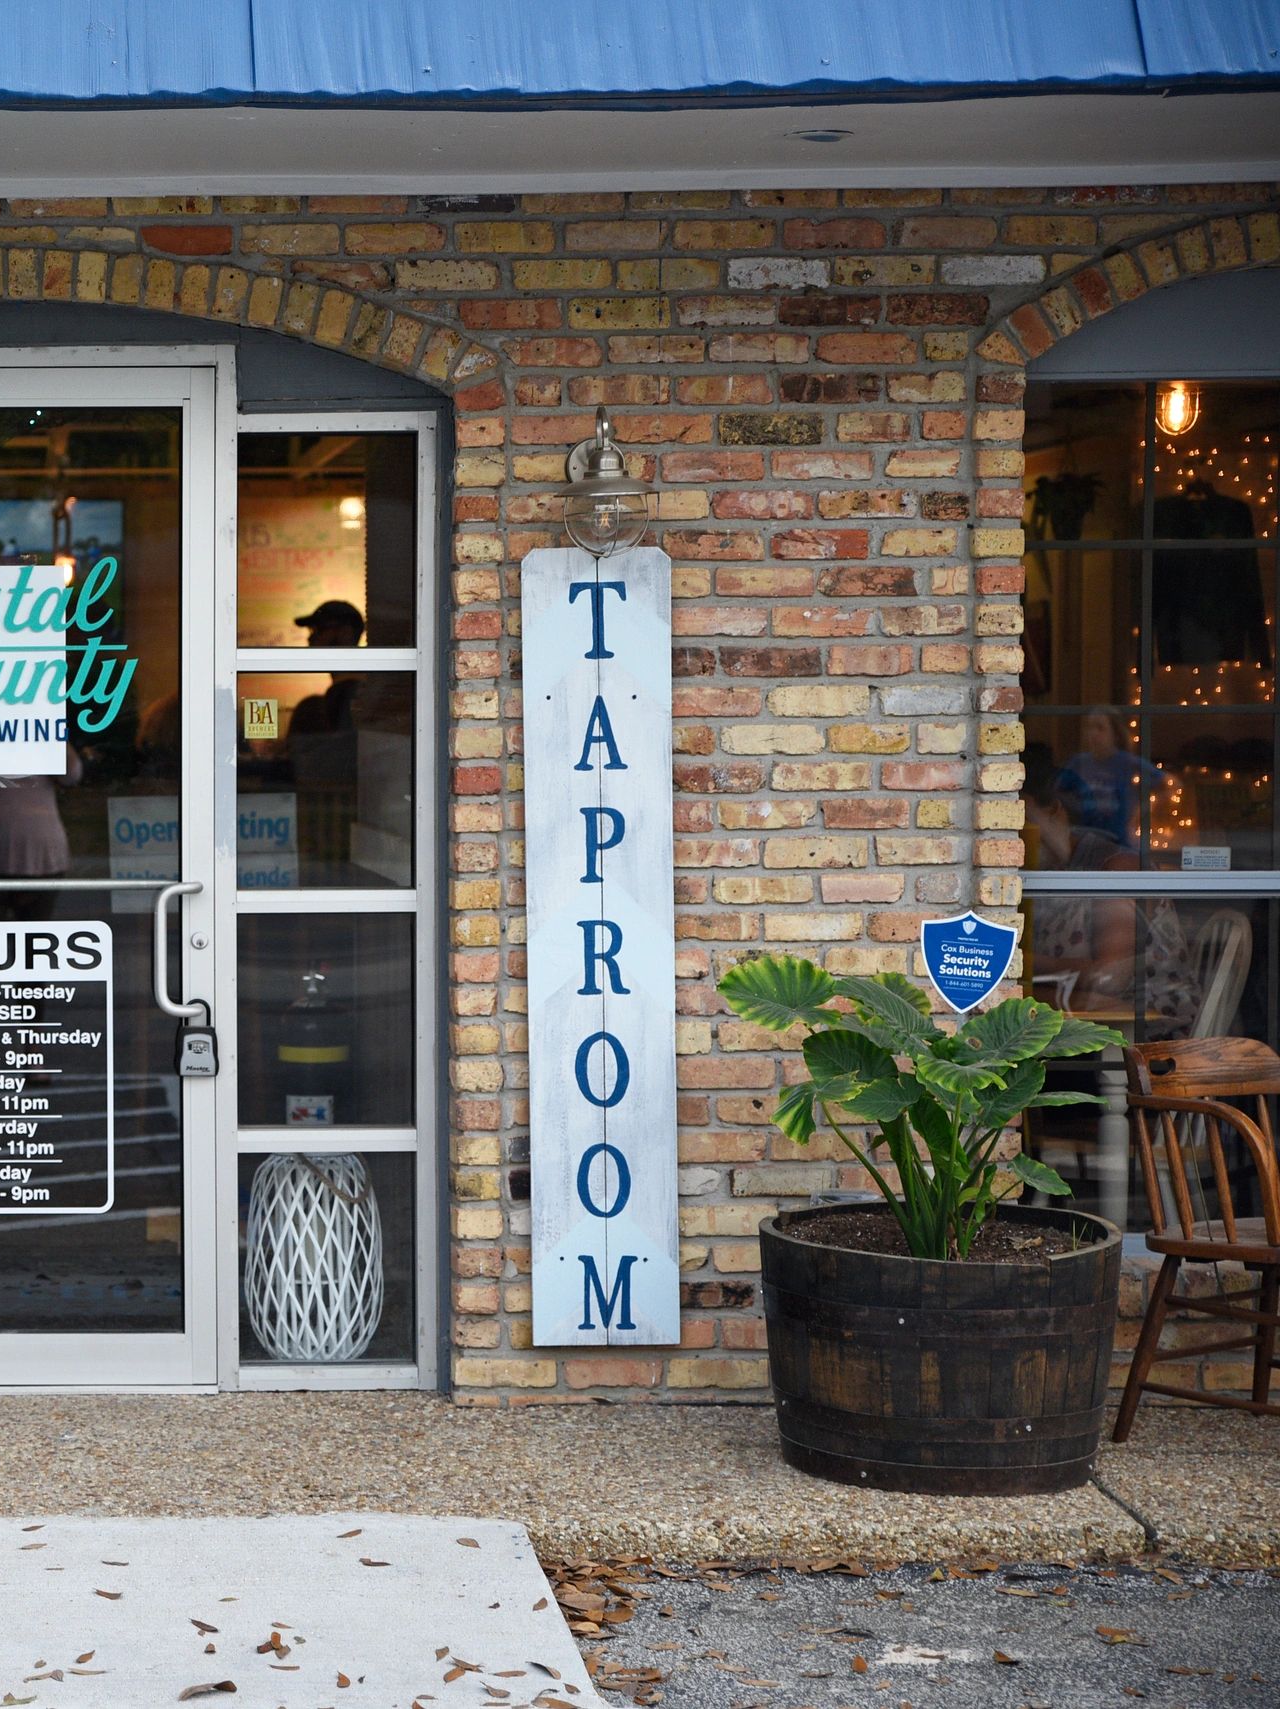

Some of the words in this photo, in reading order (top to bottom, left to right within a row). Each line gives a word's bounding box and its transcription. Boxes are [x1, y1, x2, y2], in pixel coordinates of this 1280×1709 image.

[114, 816, 179, 849] Open
[569, 581, 638, 1331] TAPROOM
[941, 944, 957, 953] Cox
[959, 945, 994, 956] Business
[939, 964, 992, 978] Solutions
[943, 954, 990, 969] Security
[1, 1031, 13, 1045] &
[17, 1029, 102, 1048] Thursday
[5, 1050, 44, 1069] 9pm
[1, 1095, 49, 1114] 11pm
[6, 1140, 55, 1159] 11pm
[11, 1185, 50, 1204] 9pm
